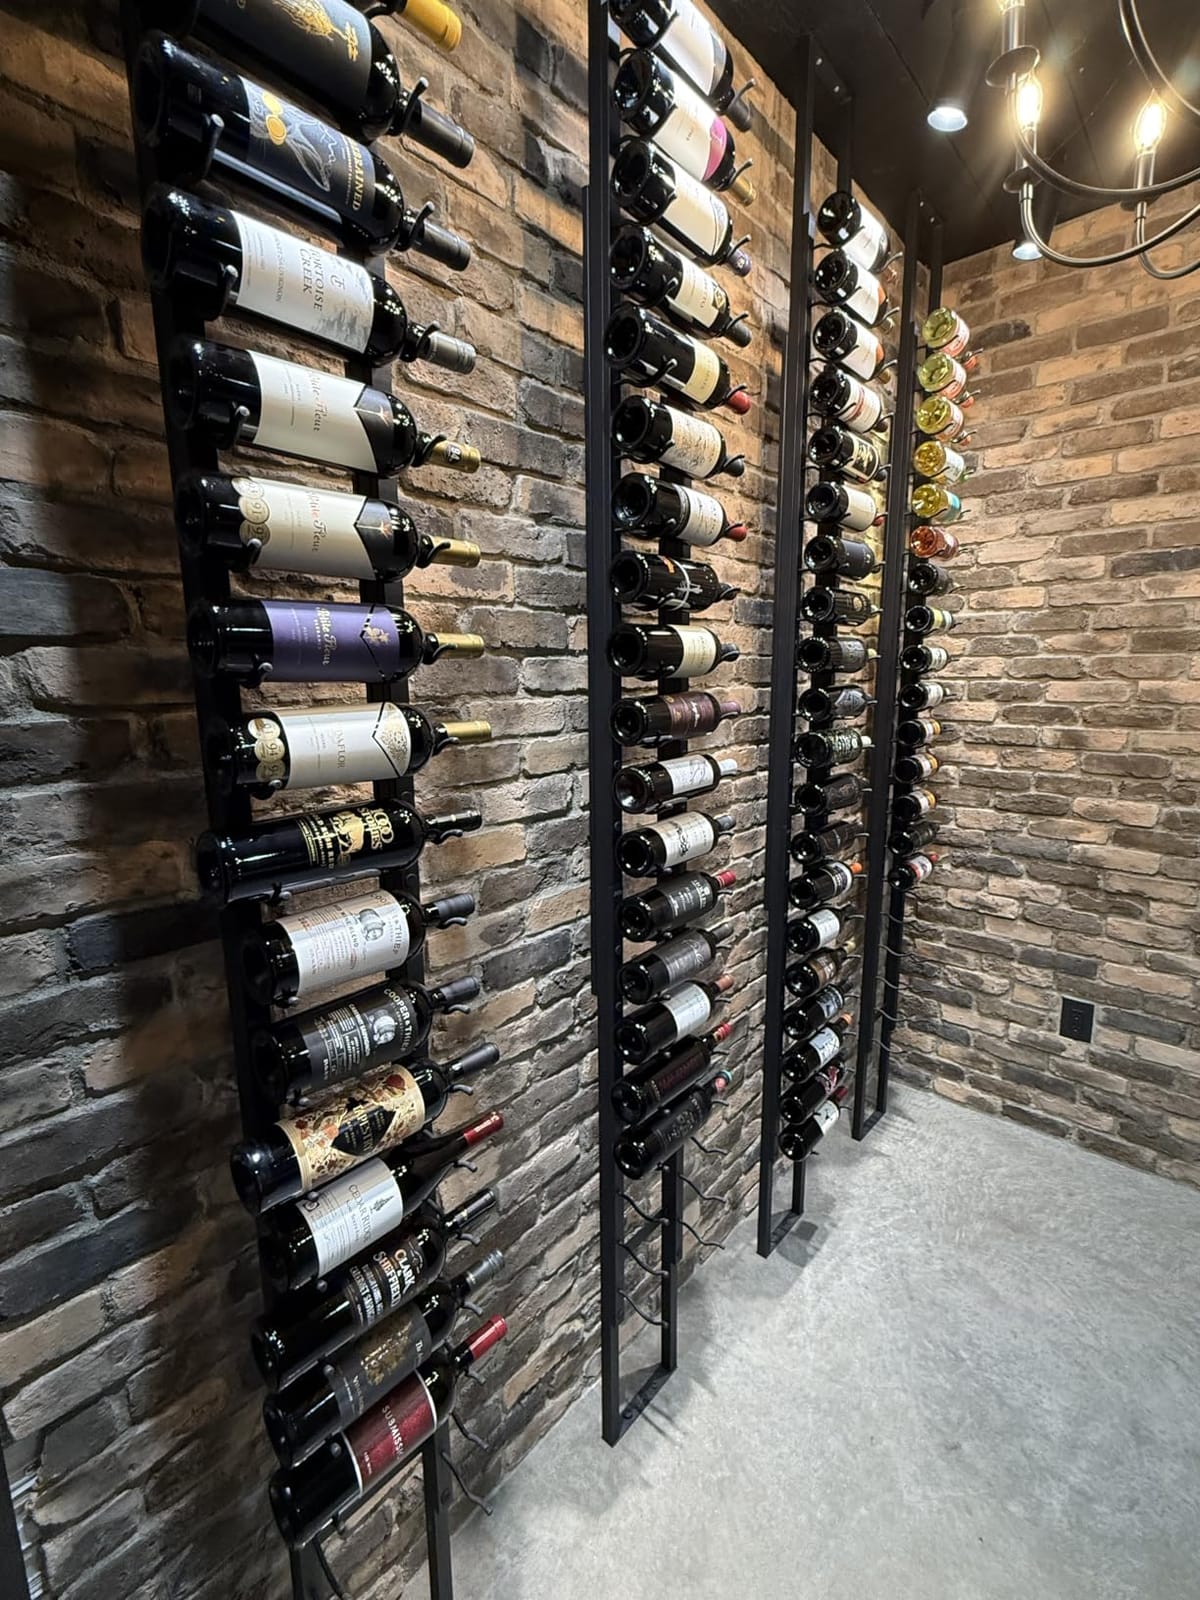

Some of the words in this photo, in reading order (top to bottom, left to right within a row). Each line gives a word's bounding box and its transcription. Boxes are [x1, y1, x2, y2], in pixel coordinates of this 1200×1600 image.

[299, 249, 313, 295] CREEK
[309, 249, 324, 311] TORTOISE
[356, 807, 383, 850] STORIES
[370, 807, 395, 844] 1000
[383, 988, 410, 1019] COOPER
[352, 1104, 373, 1150] TAPESTRY
[348, 1183, 367, 1215] CEDAR
[371, 1250, 400, 1307] SHEFFIELD
[393, 1248, 415, 1294] CLARK
[379, 1405, 403, 1457] SUBMISS
